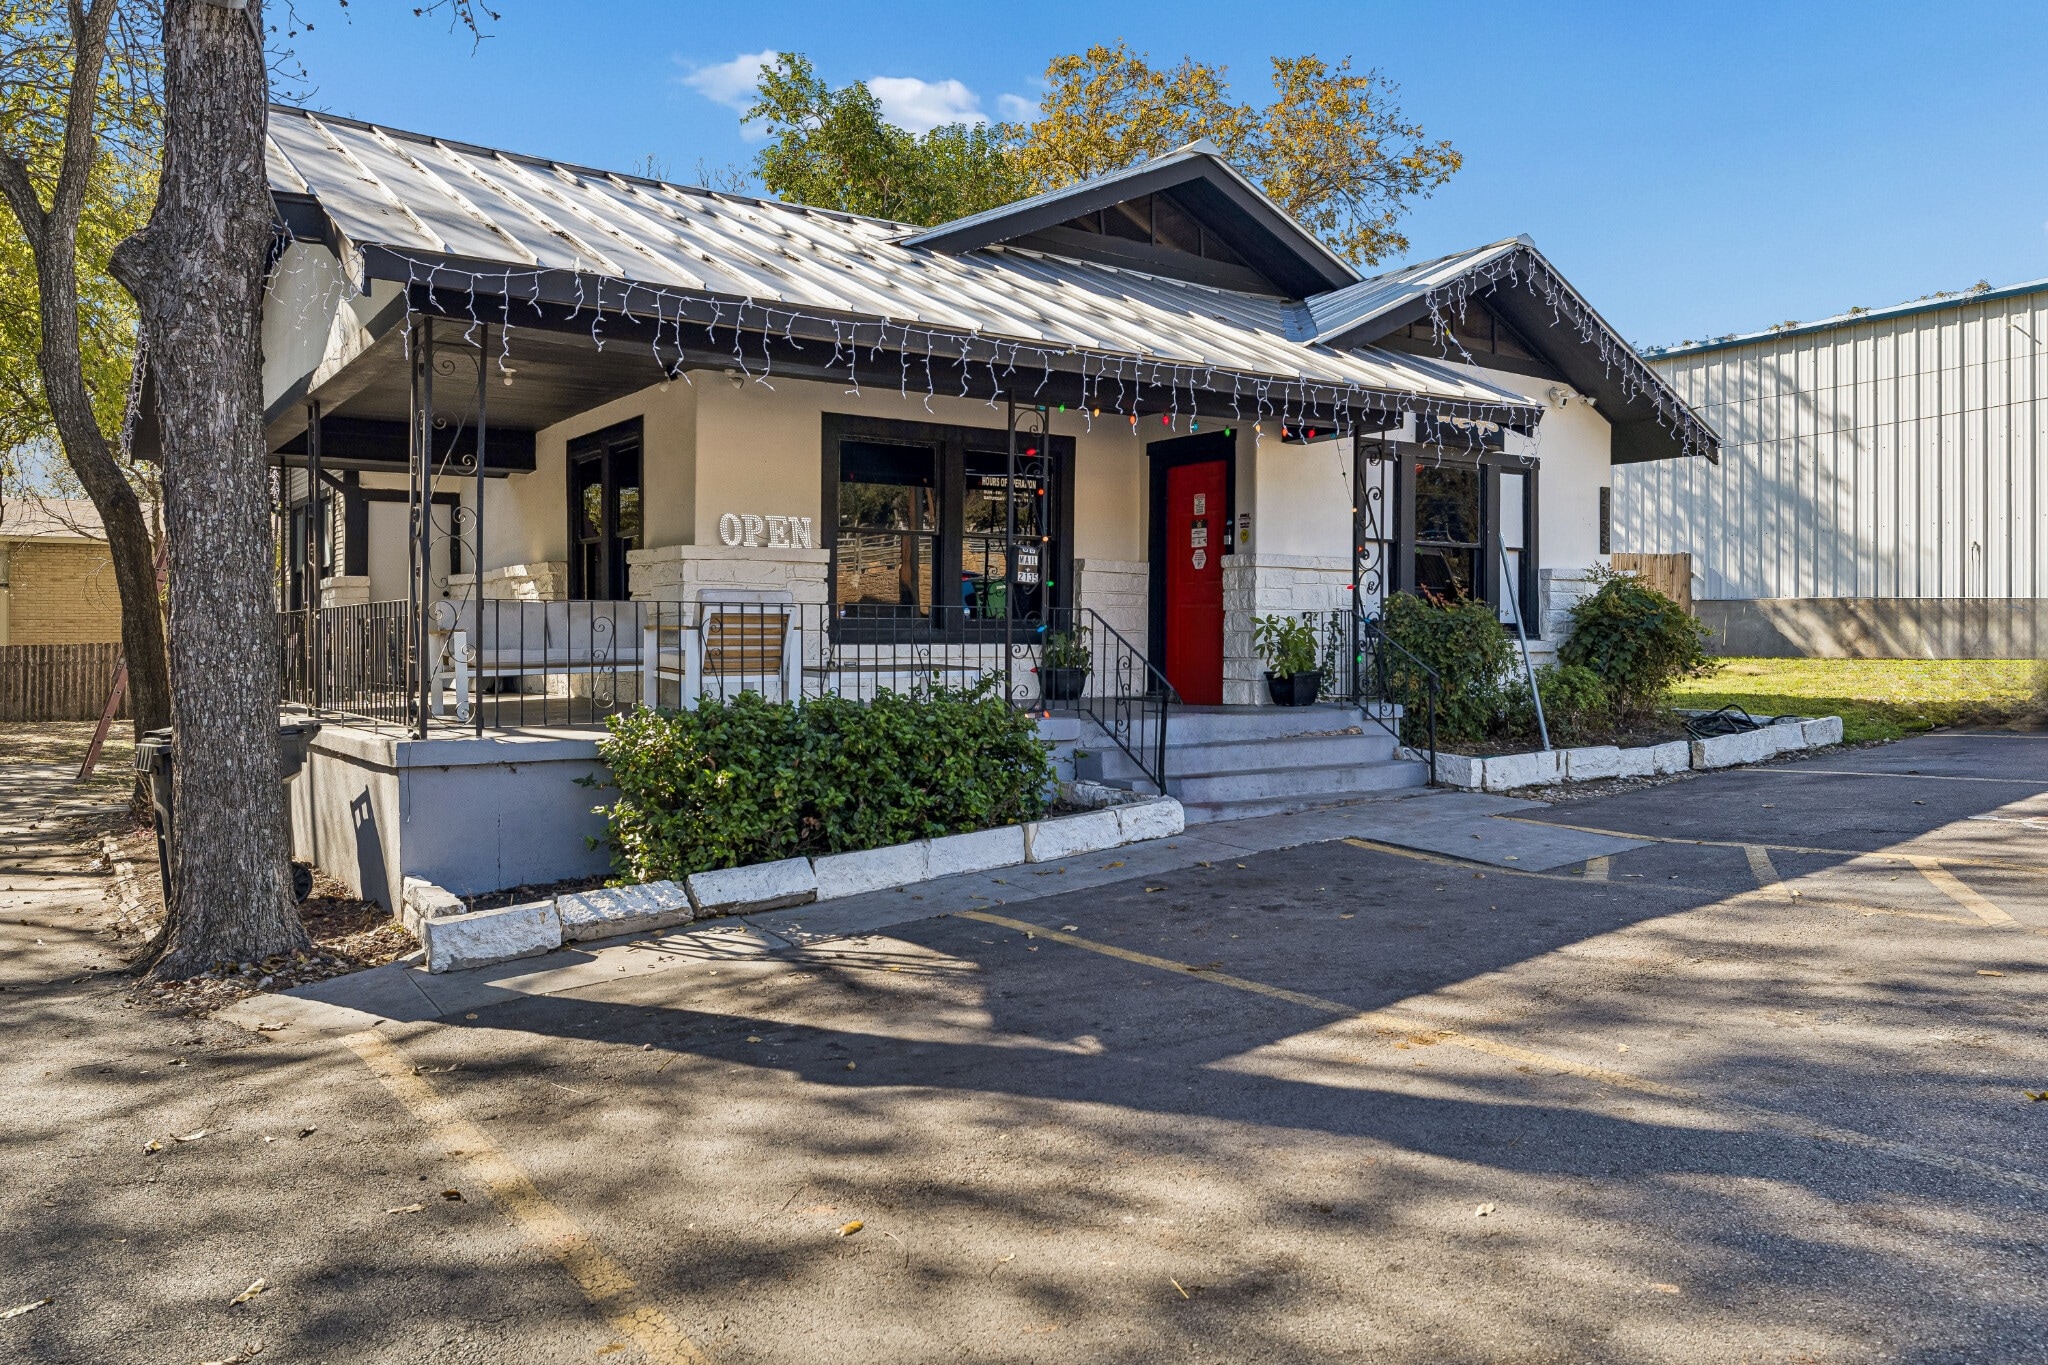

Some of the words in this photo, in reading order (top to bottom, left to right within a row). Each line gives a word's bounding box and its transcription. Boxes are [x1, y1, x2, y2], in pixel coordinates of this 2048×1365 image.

[981, 477, 1000, 487] HOURS
[1000, 477, 1008, 488] OF
[719, 512, 812, 549] OPEN
[1019, 555, 1037, 565] MAIL
[1018, 572, 1038, 583] 2135
